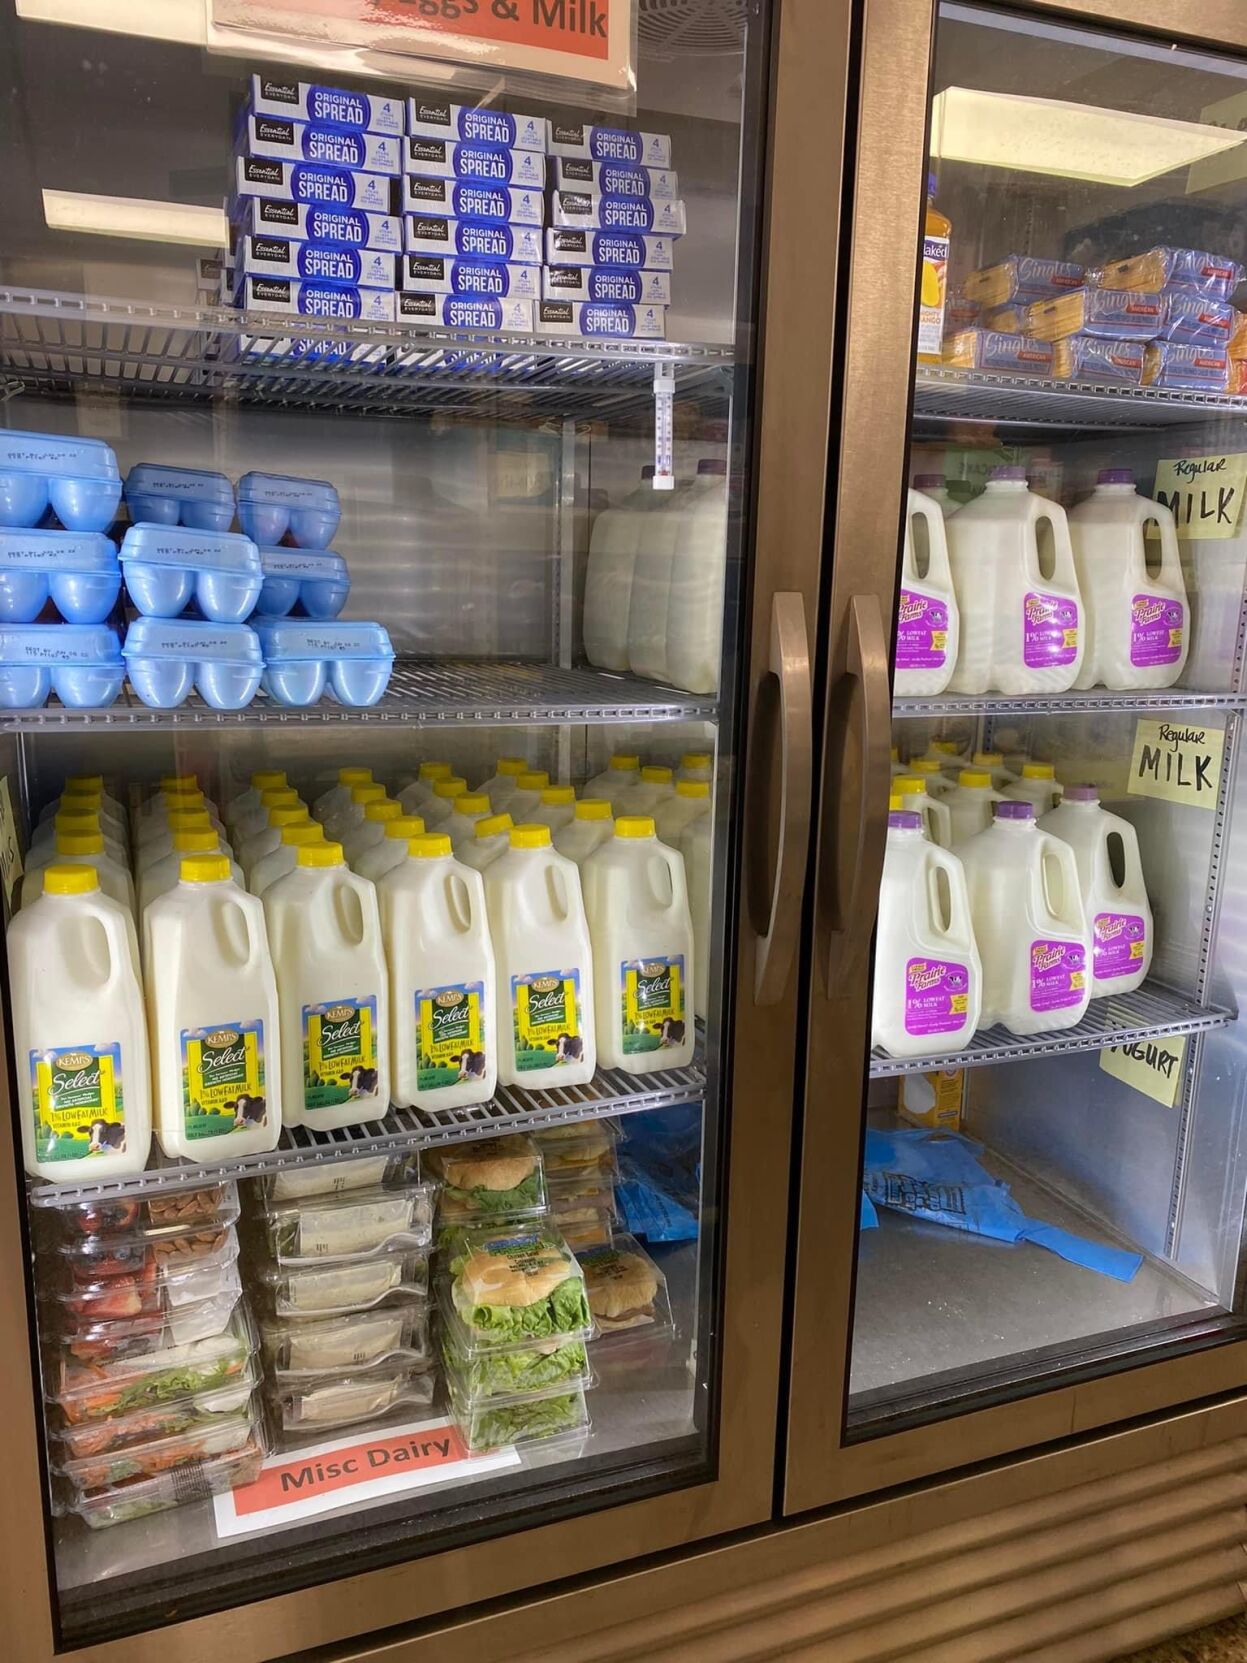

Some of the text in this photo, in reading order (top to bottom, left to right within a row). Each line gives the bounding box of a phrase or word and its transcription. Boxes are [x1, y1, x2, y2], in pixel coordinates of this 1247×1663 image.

[399, 0, 479, 19] ggs
[533, 0, 607, 38] Milk
[265, 82, 296, 95] Essential
[315, 92, 362, 107] ORIGINAL
[315, 102, 363, 124] SPREAD
[383, 103, 390, 112] 4
[419, 106, 448, 117] Essential
[465, 113, 508, 127] ORIGINAL
[527, 121, 534, 130] 4
[260, 123, 290, 135] Essential
[465, 123, 509, 142] SPREAD
[556, 127, 581, 137] Essential
[310, 133, 357, 147] ORIGINAL
[597, 133, 636, 144] ORIGINAL
[653, 139, 659, 148] 4
[310, 142, 358, 163] SPREAD
[378, 142, 385, 151] 4
[414, 144, 442, 153] Essential
[596, 141, 637, 160] SPREAD
[461, 150, 504, 162] ORIGINAL
[524, 156, 531, 165] 4
[249, 165, 279, 176] Essential
[461, 158, 505, 178] SPREAD
[566, 163, 590, 173] Essential
[300, 172, 347, 185] ORIGINAL
[605, 169, 643, 181] ORIGINAL
[660, 175, 666, 184] 4
[368, 180, 375, 190] 4
[414, 183, 442, 193] Essential
[605, 177, 644, 196] SPREAD
[299, 182, 347, 202] SPREAD
[460, 189, 504, 201] ORIGINAL
[523, 195, 530, 204] 4
[264, 205, 295, 216] Essential
[460, 197, 504, 216] SPREAD
[606, 202, 646, 212] ORIGINAL
[664, 205, 671, 213] 4
[314, 212, 361, 225] ORIGINAL
[605, 211, 647, 227] SPREAD
[382, 221, 389, 230] 4
[417, 222, 445, 233] Essential
[314, 222, 362, 242] SPREAD
[463, 228, 505, 239] ORIGINAL
[525, 233, 531, 241] 4
[256, 243, 286, 254] Essential
[463, 236, 506, 255] SPREAD
[599, 239, 639, 248] ORIGINAL
[656, 242, 662, 250] 4
[306, 250, 352, 263] ORIGINAL
[374, 257, 381, 266] 4
[599, 247, 639, 264] SPREAD
[305, 259, 353, 279] SPREAD
[413, 262, 441, 272] Essential
[459, 267, 501, 277] ORIGINAL
[521, 270, 528, 279] 4
[595, 275, 635, 284] ORIGINAL
[458, 276, 502, 292] SPREAD
[652, 277, 659, 285] 4
[256, 284, 287, 294] Essential
[595, 284, 635, 300] SPREAD
[307, 290, 353, 302] ORIGINAL
[374, 296, 381, 305] 4
[306, 299, 353, 318] SPREAD
[404, 299, 432, 308] Essential
[451, 302, 494, 312] ORIGINAL
[514, 304, 521, 313] 4
[543, 307, 569, 316] Essential
[587, 309, 628, 317] ORIGINAL
[647, 310, 653, 318] 4
[450, 312, 495, 328] SPREAD
[586, 318, 629, 332] SPREAD
[1173, 458, 1227, 483] Regular
[1156, 487, 1235, 529] MILK
[1159, 724, 1205, 752] Regular
[1139, 745, 1212, 791] MILK
[634, 977, 670, 999] Select
[525, 991, 565, 1014] Select
[908, 999, 922, 1008] 1%
[429, 1005, 469, 1030] Select
[207, 1034, 237, 1044] KEMPS
[317, 1021, 360, 1047] Select
[59, 1055, 91, 1066] KEMPS
[198, 1046, 246, 1073] Select
[1111, 1041, 1178, 1079] OGURT
[48, 1070, 100, 1095] Select
[280, 1438, 450, 1492] Misc Dairy
